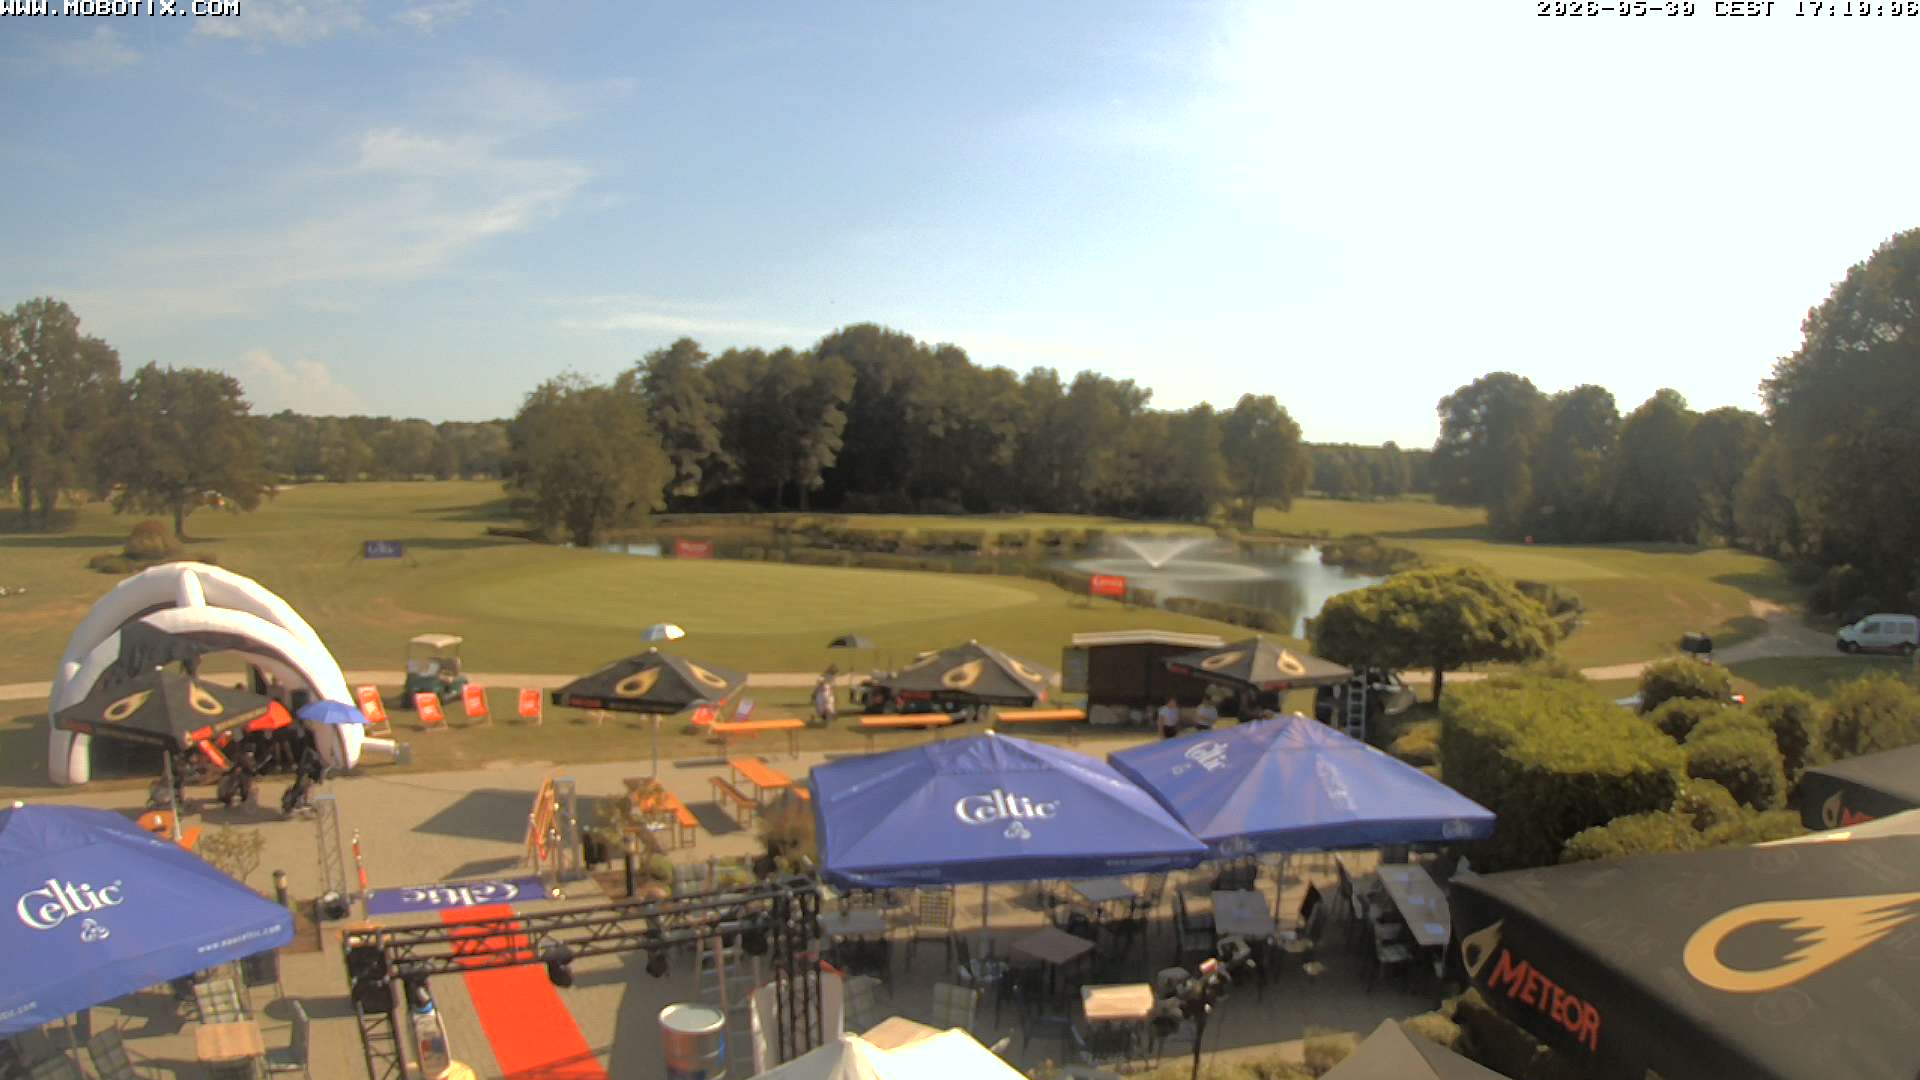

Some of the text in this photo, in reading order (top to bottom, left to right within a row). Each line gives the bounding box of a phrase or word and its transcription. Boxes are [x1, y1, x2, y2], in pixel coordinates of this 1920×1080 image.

[954, 788, 1057, 825] Celtic
[17, 879, 123, 929] Celtic
[1488, 948, 1600, 1053] METEOR
